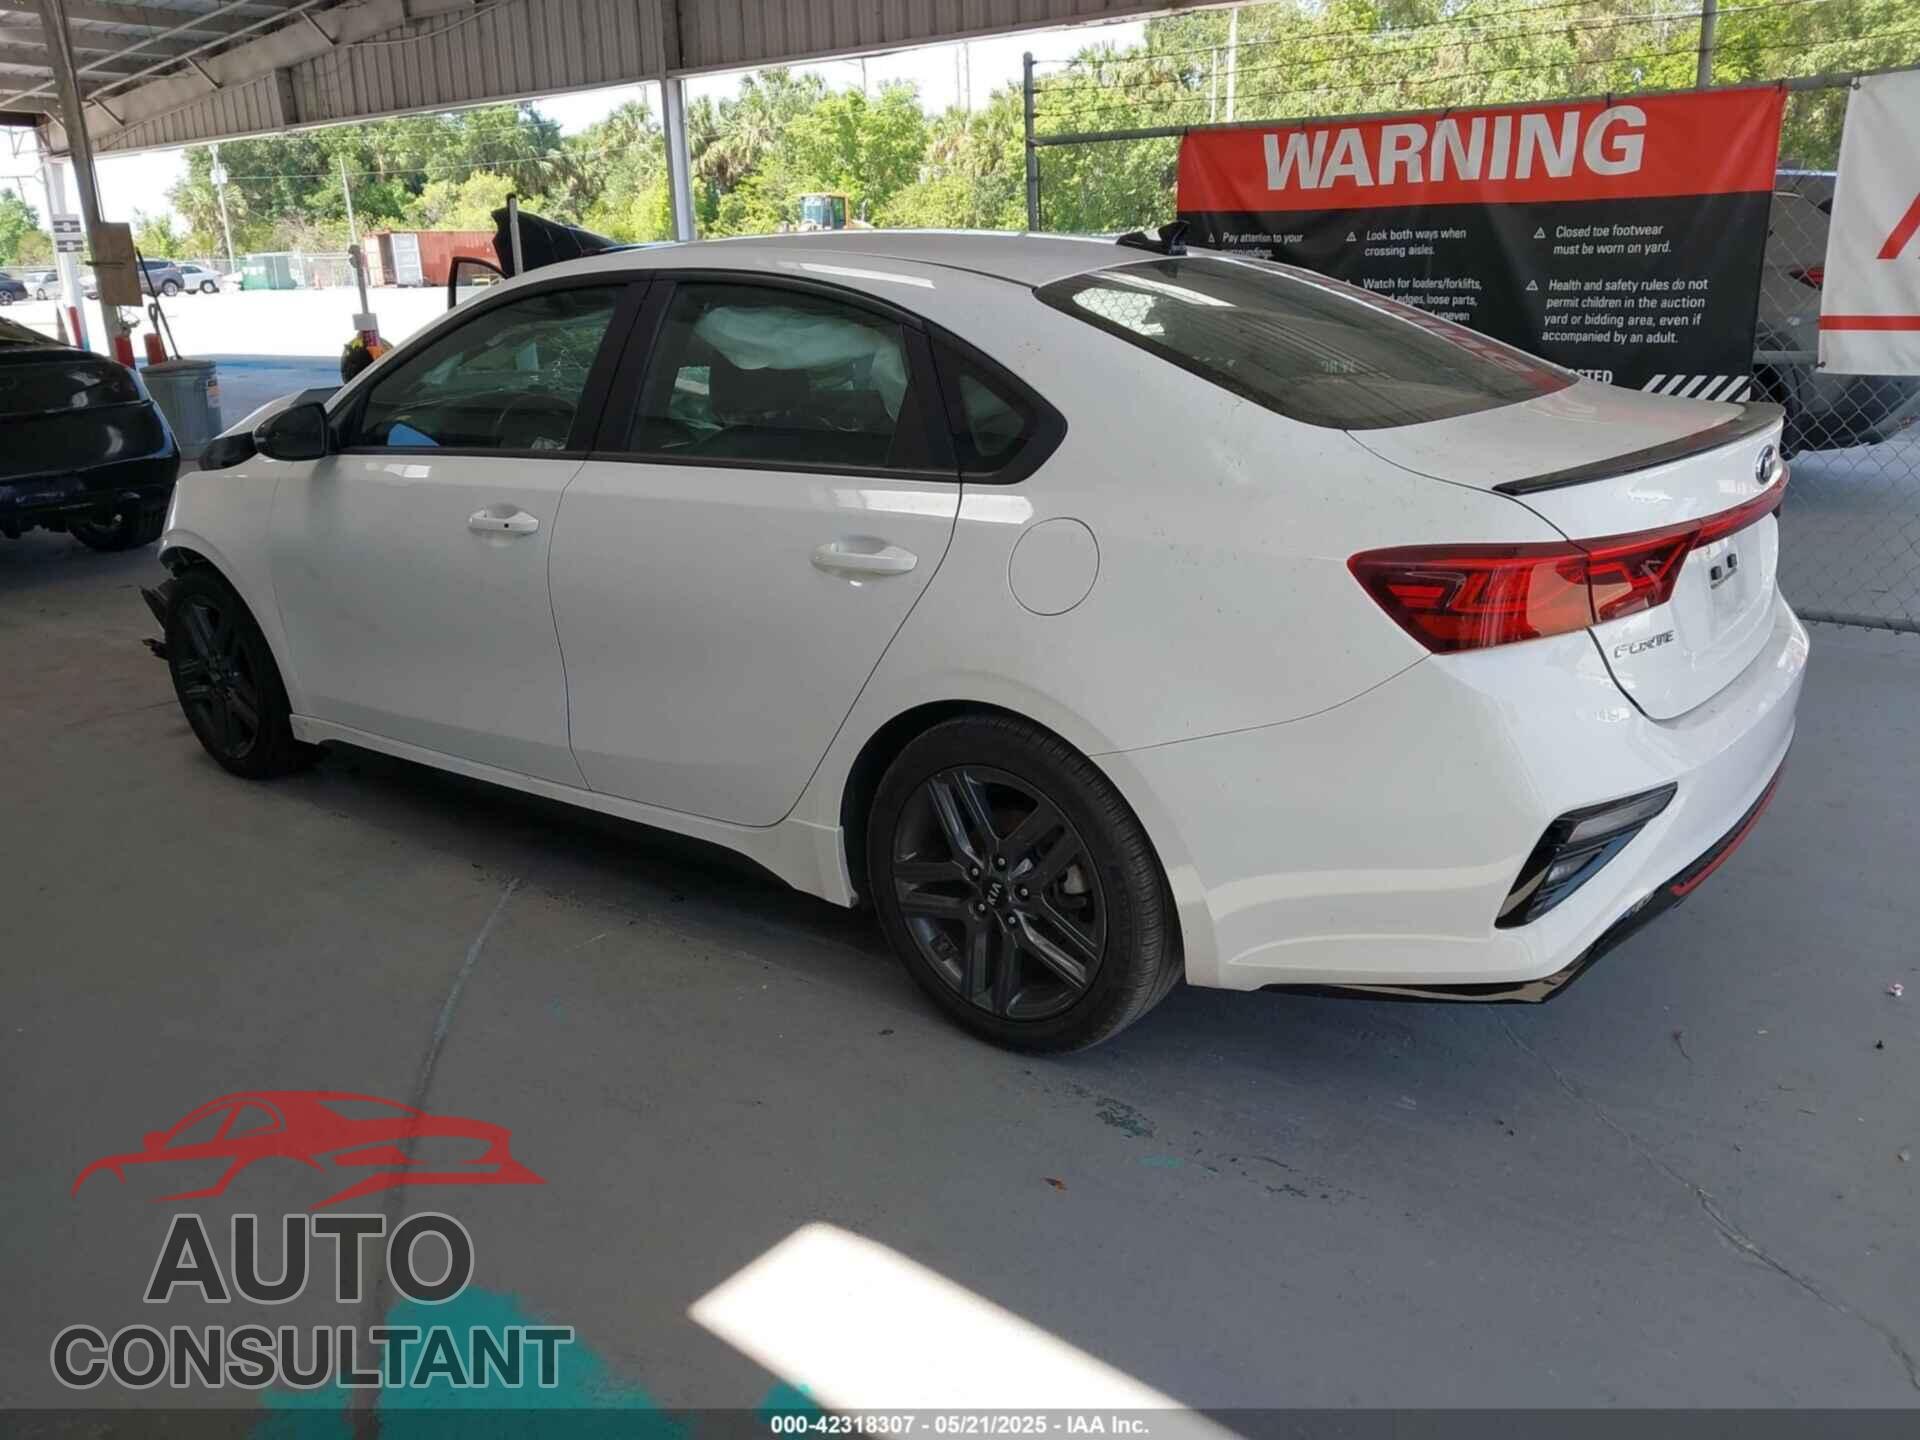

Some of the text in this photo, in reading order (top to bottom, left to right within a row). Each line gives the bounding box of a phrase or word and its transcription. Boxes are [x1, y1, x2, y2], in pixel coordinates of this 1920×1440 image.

[1263, 105, 1647, 191] WARNING
[1366, 227, 1466, 241] Look both ways when
[1556, 224, 1665, 238] Closed toe footwear
[1222, 232, 1239, 244] Pay
[1273, 233, 1282, 243] to
[1283, 234, 1304, 245] your
[1364, 244, 1435, 257] crossing aisles.
[1553, 240, 1672, 256] must be worn on yard.
[1363, 278, 1482, 290] Watch for loaders/forklifts,
[1548, 278, 1709, 293] Health and safety rules do not
[1426, 293, 1450, 305] loose
[1452, 295, 1477, 307] parts,
[1546, 296, 1705, 309] permit children in the auction
[1544, 313, 1702, 327] yard or bidding area, even if
[1542, 331, 1679, 345] accompanied by an adult.
